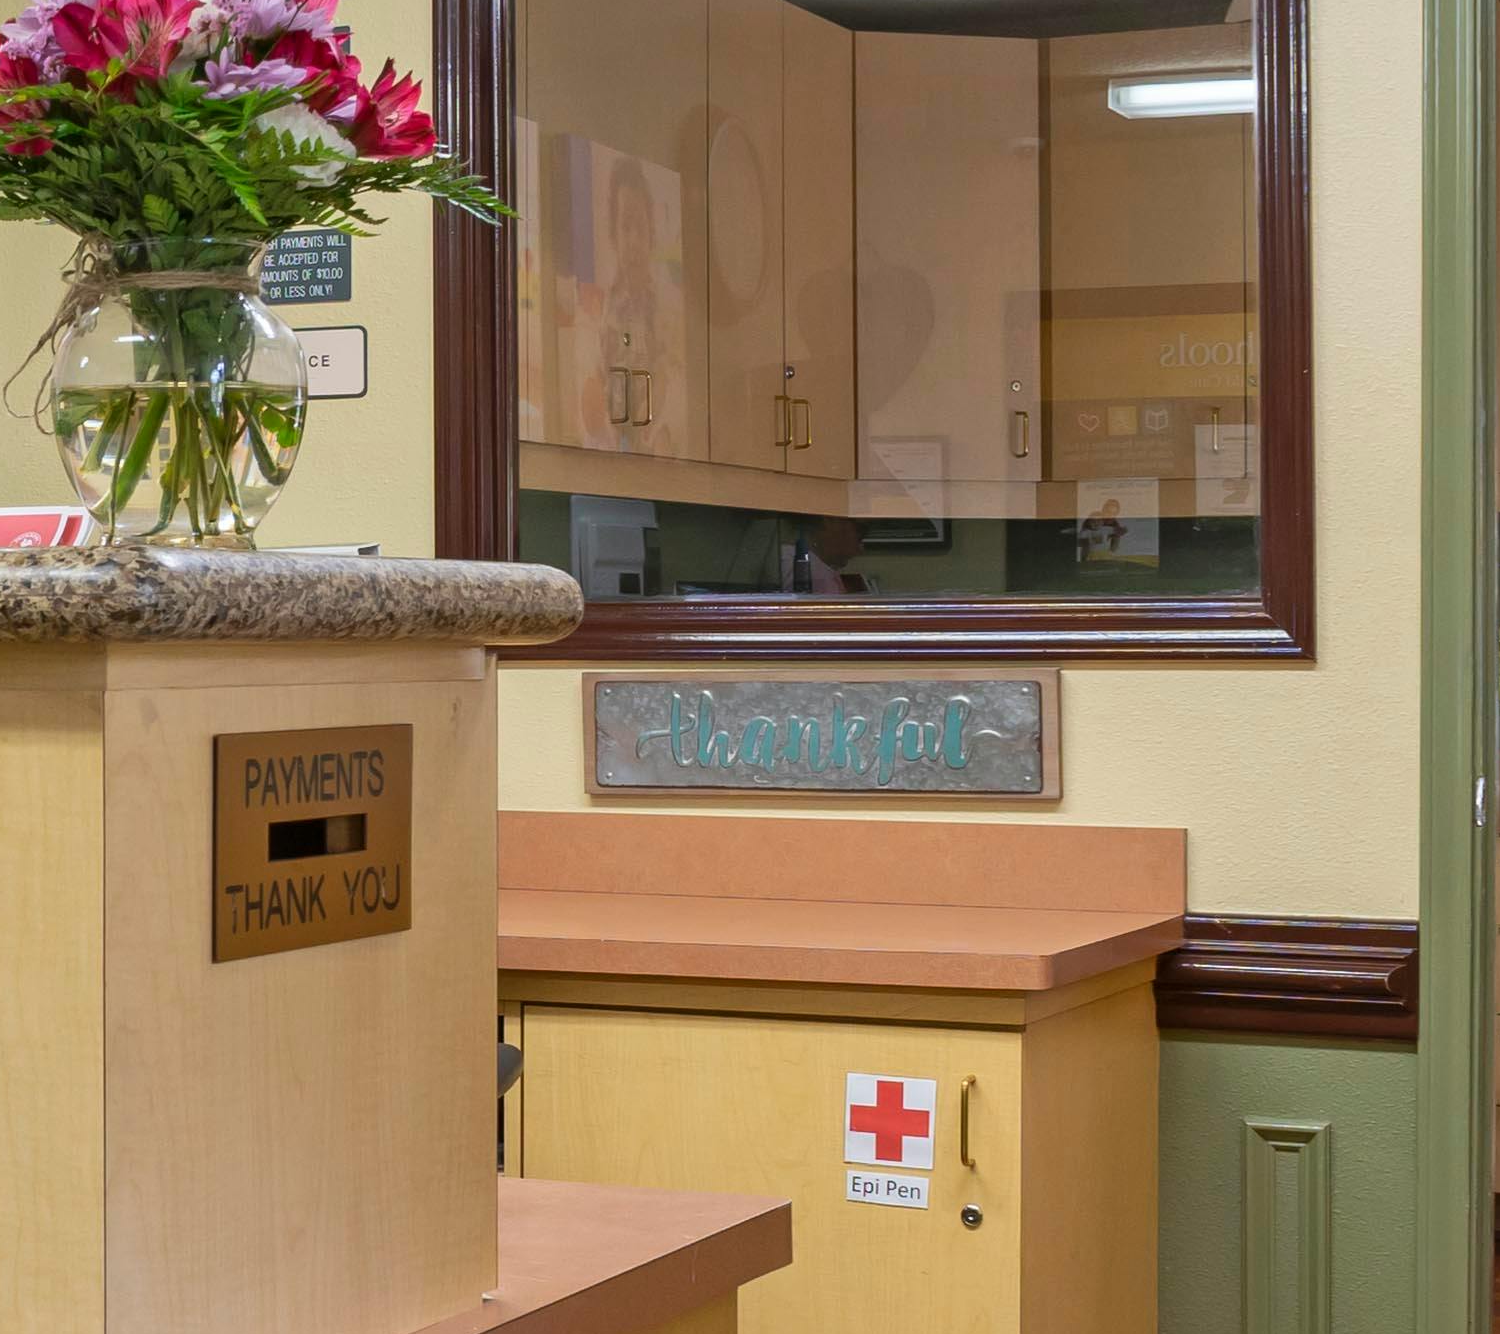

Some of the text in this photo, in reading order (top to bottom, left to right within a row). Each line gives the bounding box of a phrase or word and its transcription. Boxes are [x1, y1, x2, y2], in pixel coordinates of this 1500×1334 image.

[281, 234, 324, 250] PAYMENTS
[327, 234, 347, 247] WILL
[264, 251, 339, 267] BE ACCEPTED FOR
[261, 267, 343, 284] AMOUNTS OF $10.00
[270, 287, 282, 300] OR
[284, 286, 306, 299] LESS
[636, 689, 1004, 785] thankful
[245, 749, 385, 809] PAYMENTS
[225, 863, 400, 935] THANK YOU
[852, 1176, 922, 1200] Epi Pen
